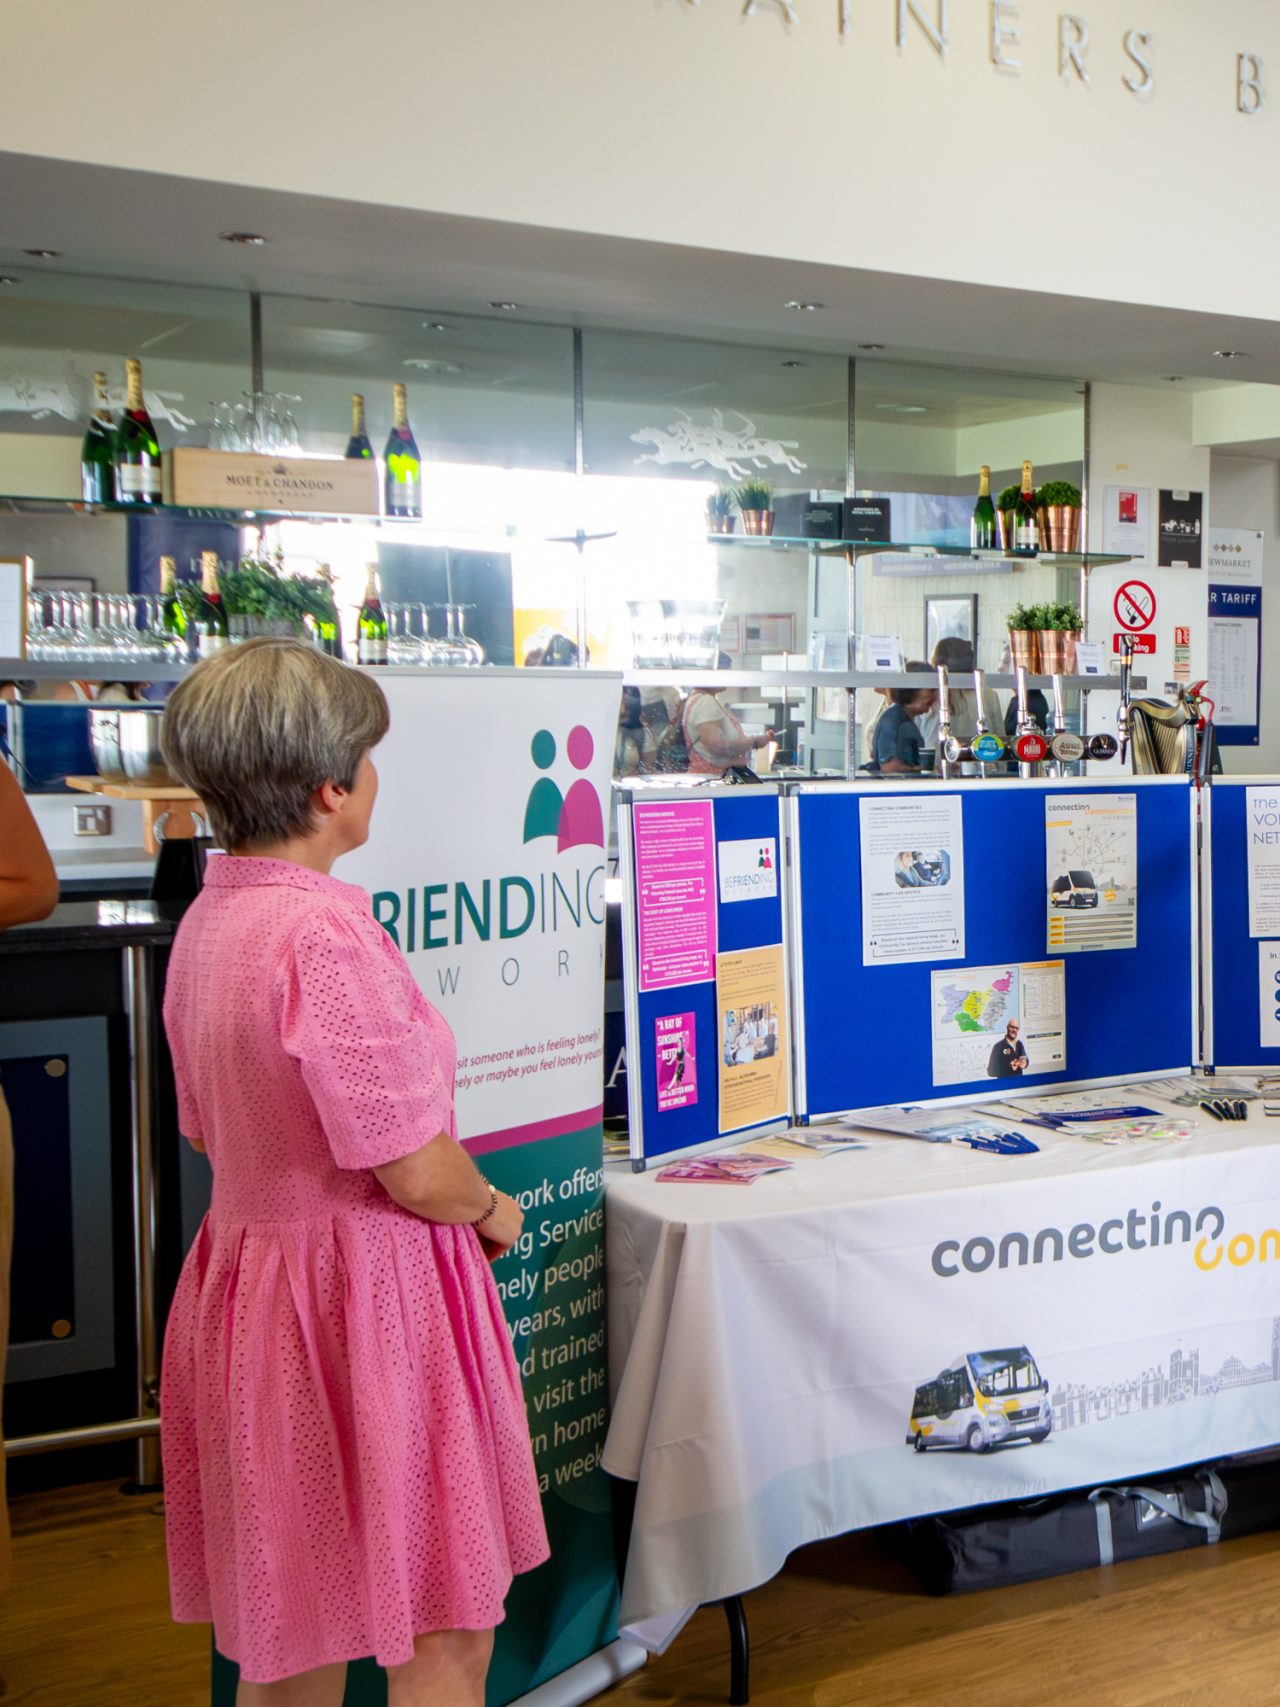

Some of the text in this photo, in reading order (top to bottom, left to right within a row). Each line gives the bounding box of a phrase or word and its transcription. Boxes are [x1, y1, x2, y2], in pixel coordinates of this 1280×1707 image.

[273, 479, 334, 490] CHANDON
[1221, 592, 1257, 604] TARIFF
[1133, 644, 1150, 653] king
[1253, 798, 1278, 809] the
[372, 865, 605, 953] RIENDING
[457, 1057, 468, 1069] sit
[470, 1050, 514, 1066] someone
[516, 1044, 536, 1058] who
[537, 1042, 545, 1054] is
[546, 1037, 576, 1052] feeling
[474, 1074, 484, 1085] or
[486, 1063, 520, 1082] maybe
[521, 1064, 538, 1078] you
[540, 1057, 556, 1071] feel
[557, 1051, 583, 1068] lonely
[540, 1209, 603, 1247] Service
[931, 1201, 1224, 1277] connecting
[533, 1367, 606, 1413] visit the
[554, 1407, 606, 1447] home
